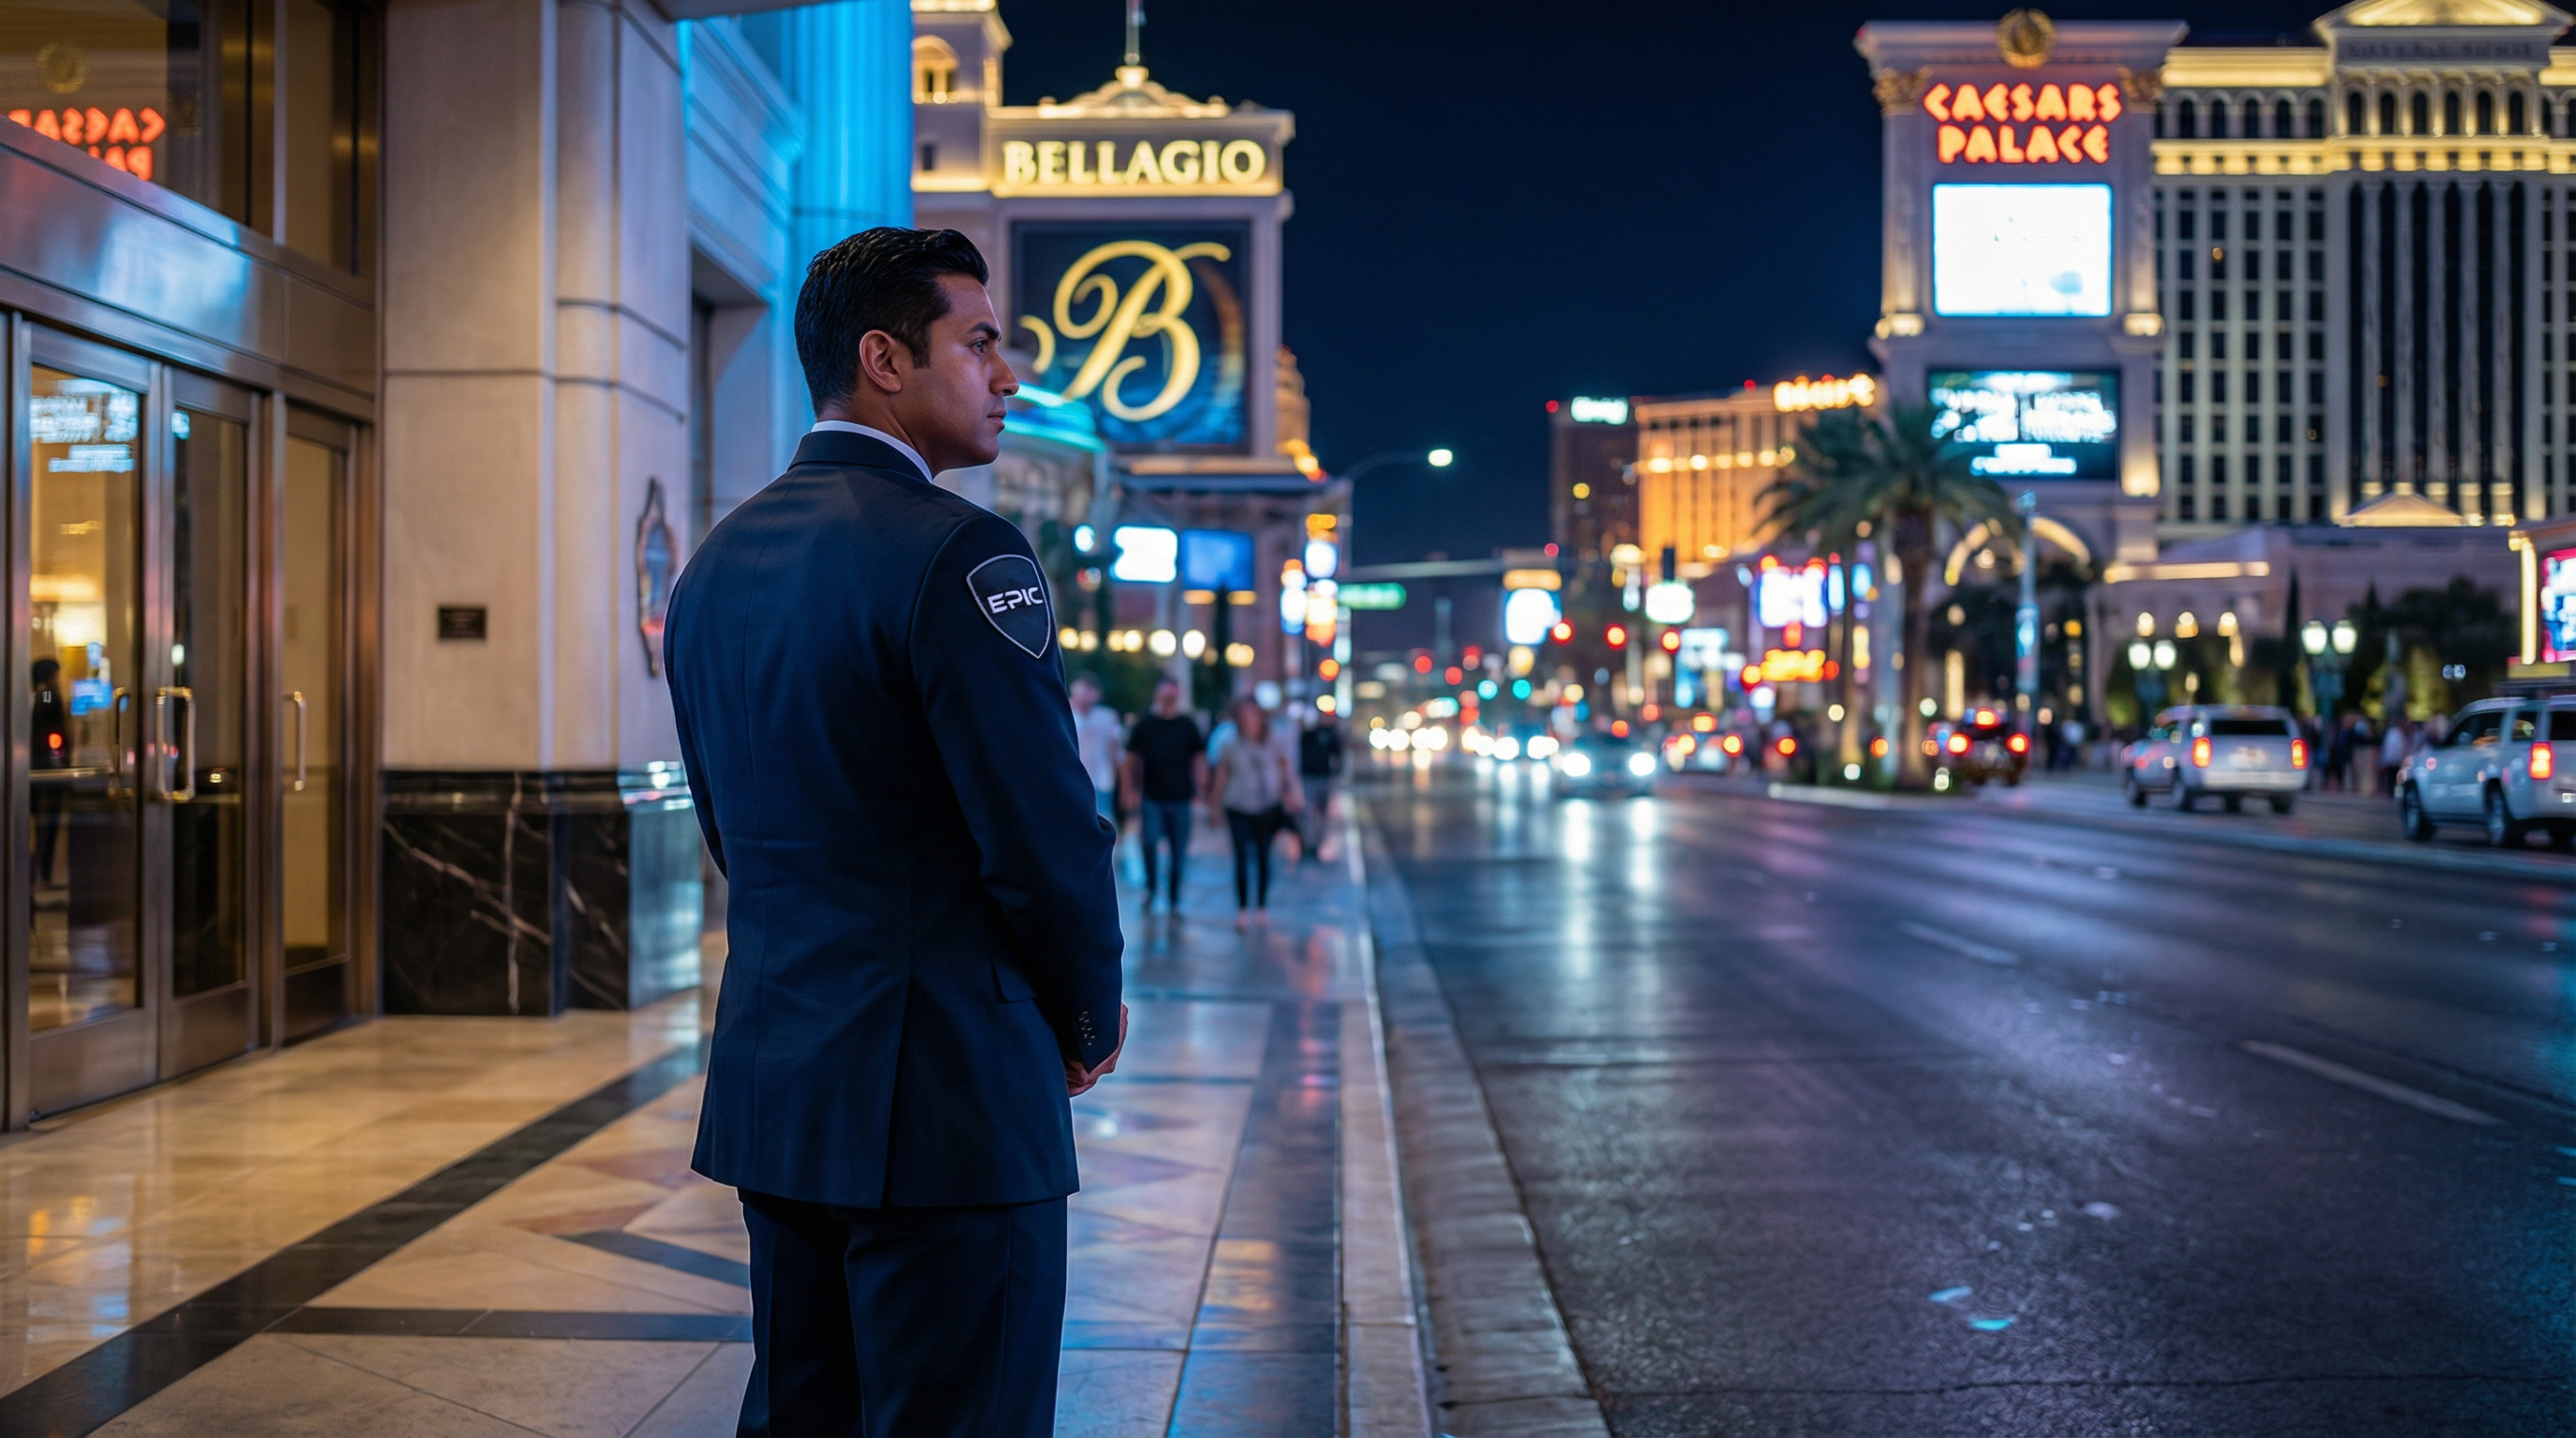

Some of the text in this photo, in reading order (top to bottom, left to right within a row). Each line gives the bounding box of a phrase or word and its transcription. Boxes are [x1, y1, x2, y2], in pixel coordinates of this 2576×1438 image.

[1923, 82, 2122, 123] CAESARS
[1003, 139, 1266, 184] BELLAGIO
[1938, 124, 2109, 164] PALACE
[987, 586, 1044, 615] EPIC
